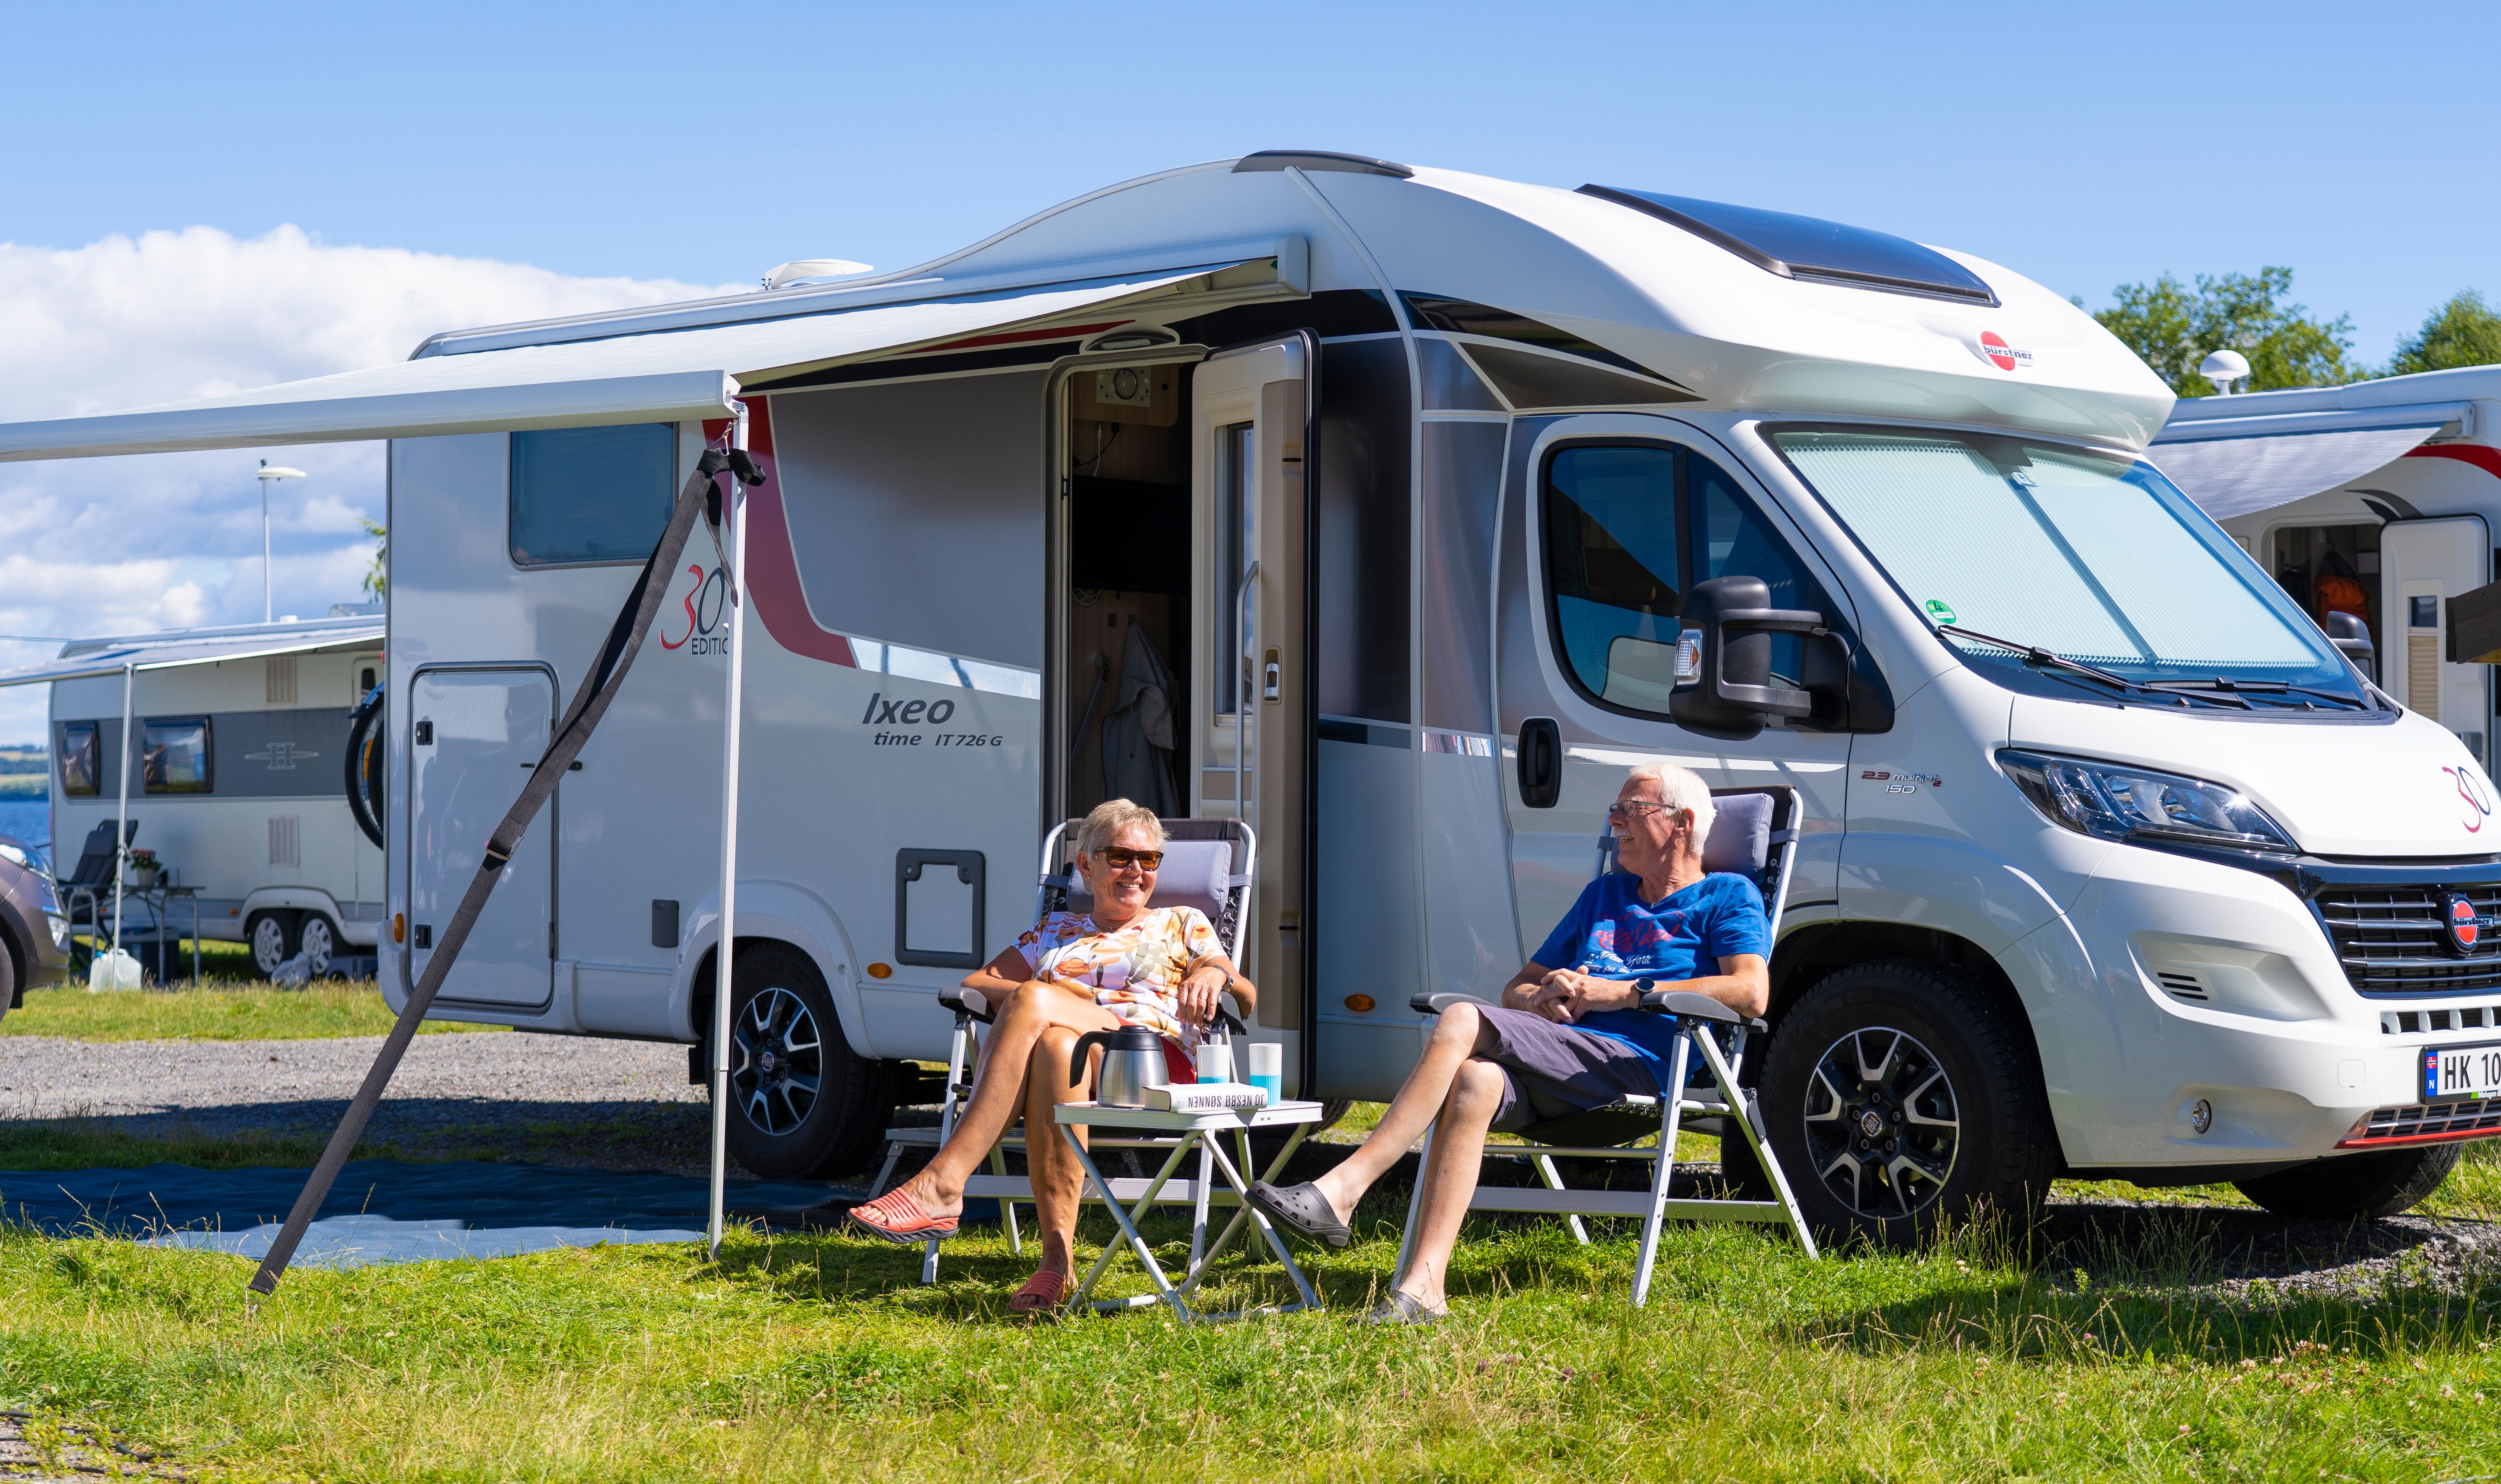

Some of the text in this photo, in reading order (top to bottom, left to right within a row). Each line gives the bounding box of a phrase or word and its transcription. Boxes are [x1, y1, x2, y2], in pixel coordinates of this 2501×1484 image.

[1983, 345, 2032, 359] bürstner
[660, 564, 725, 650] 30
[1933, 601, 1944, 612] 4
[862, 693, 955, 724] Ixeo
[874, 731, 1003, 747] time IT 726 G
[1861, 771, 1890, 780] 2.3
[1886, 784, 1916, 794] 150
[2453, 917, 2491, 926] bürstner
[1589, 951, 1651, 968] New York
[2429, 1079, 2435, 1090] N
[2444, 1055, 2471, 1090] HK
[1188, 1094, 1265, 1108] JO NESBØ SØNNEN
[2478, 1090, 2497, 1099] Mohagen
